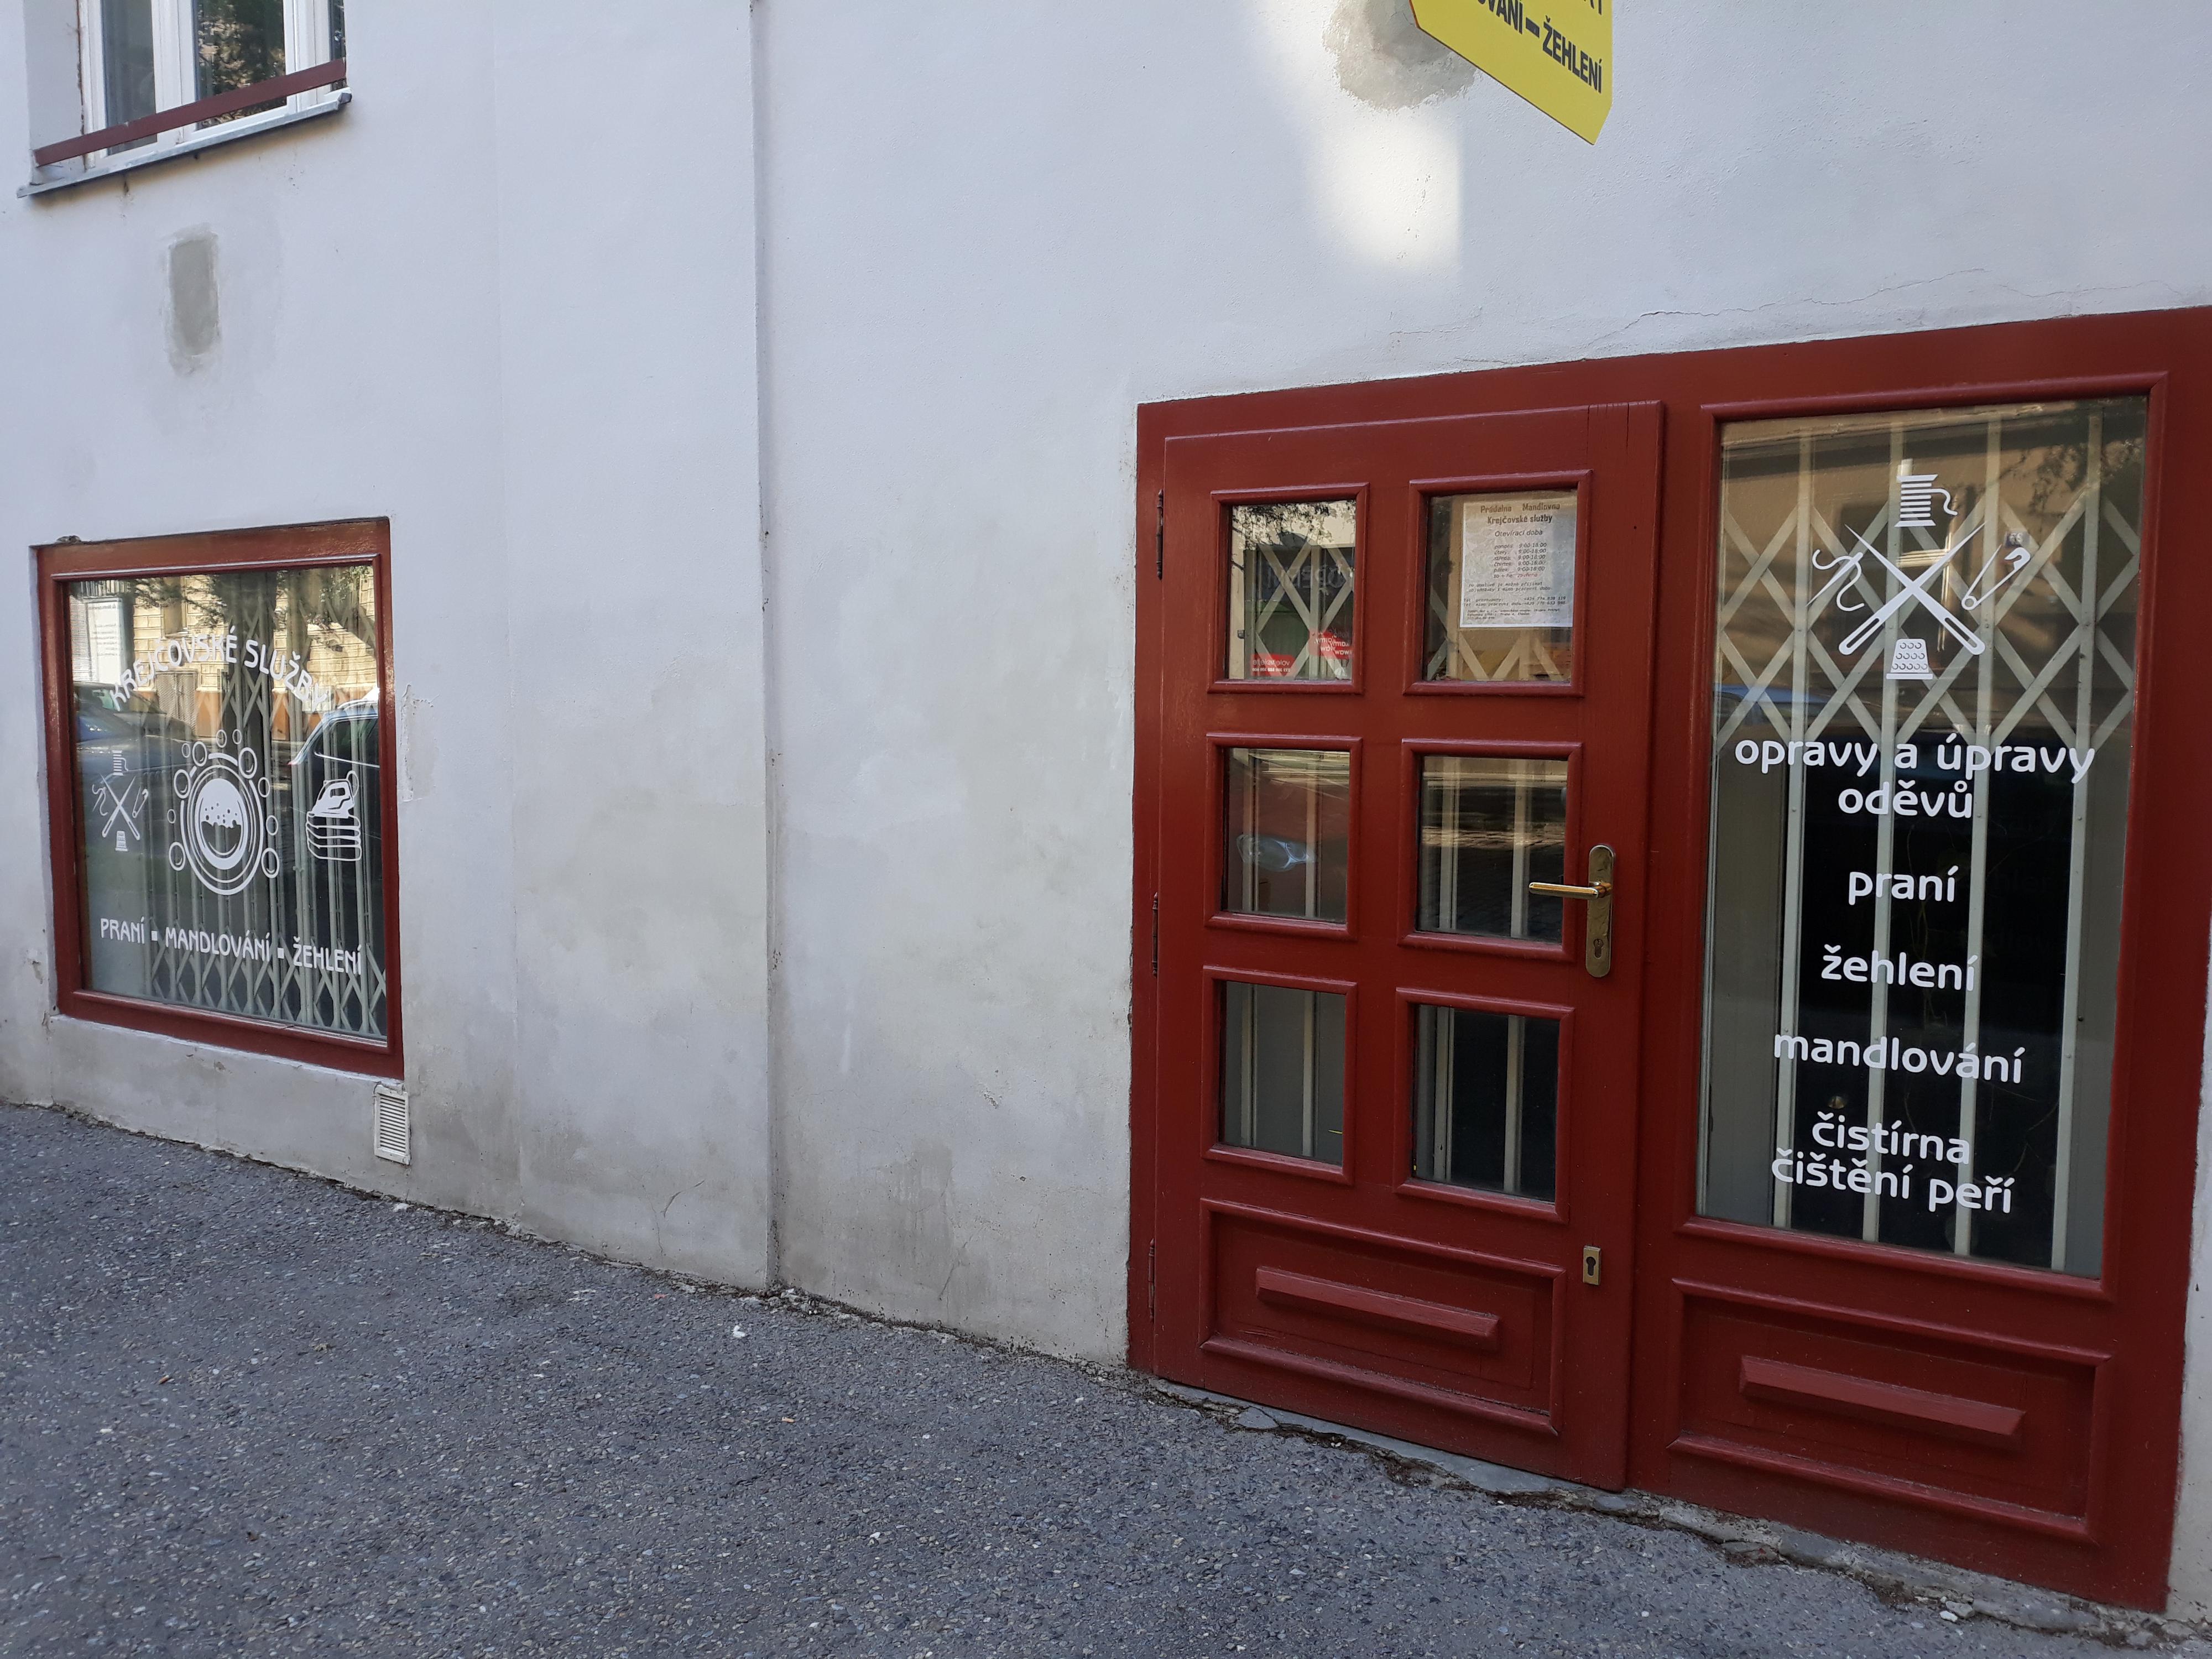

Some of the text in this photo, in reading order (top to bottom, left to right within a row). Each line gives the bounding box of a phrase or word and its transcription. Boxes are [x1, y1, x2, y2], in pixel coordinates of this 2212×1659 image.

[1542, 15, 1603, 94] ŽEHLENÍ
[1488, 514, 1553, 525] Krejčovské služby
[1522, 502, 1561, 512] Mandlovna
[110, 625, 237, 712] KREJČOVSKÉ
[244, 639, 327, 712] SLUŽBY
[1735, 733, 2095, 784] opravy a úpravy
[1838, 780, 1973, 818] oděvů
[1849, 865, 1958, 905] praní
[101, 916, 362, 975] PRANÍ MANDLOVÁNÍ ŽEHLENÍ
[1821, 944, 1978, 991] žehlení
[1774, 1034, 2025, 1083] mandlování
[1812, 1111, 1970, 1165] čistírna
[1771, 1147, 2015, 1214] čištění peří
